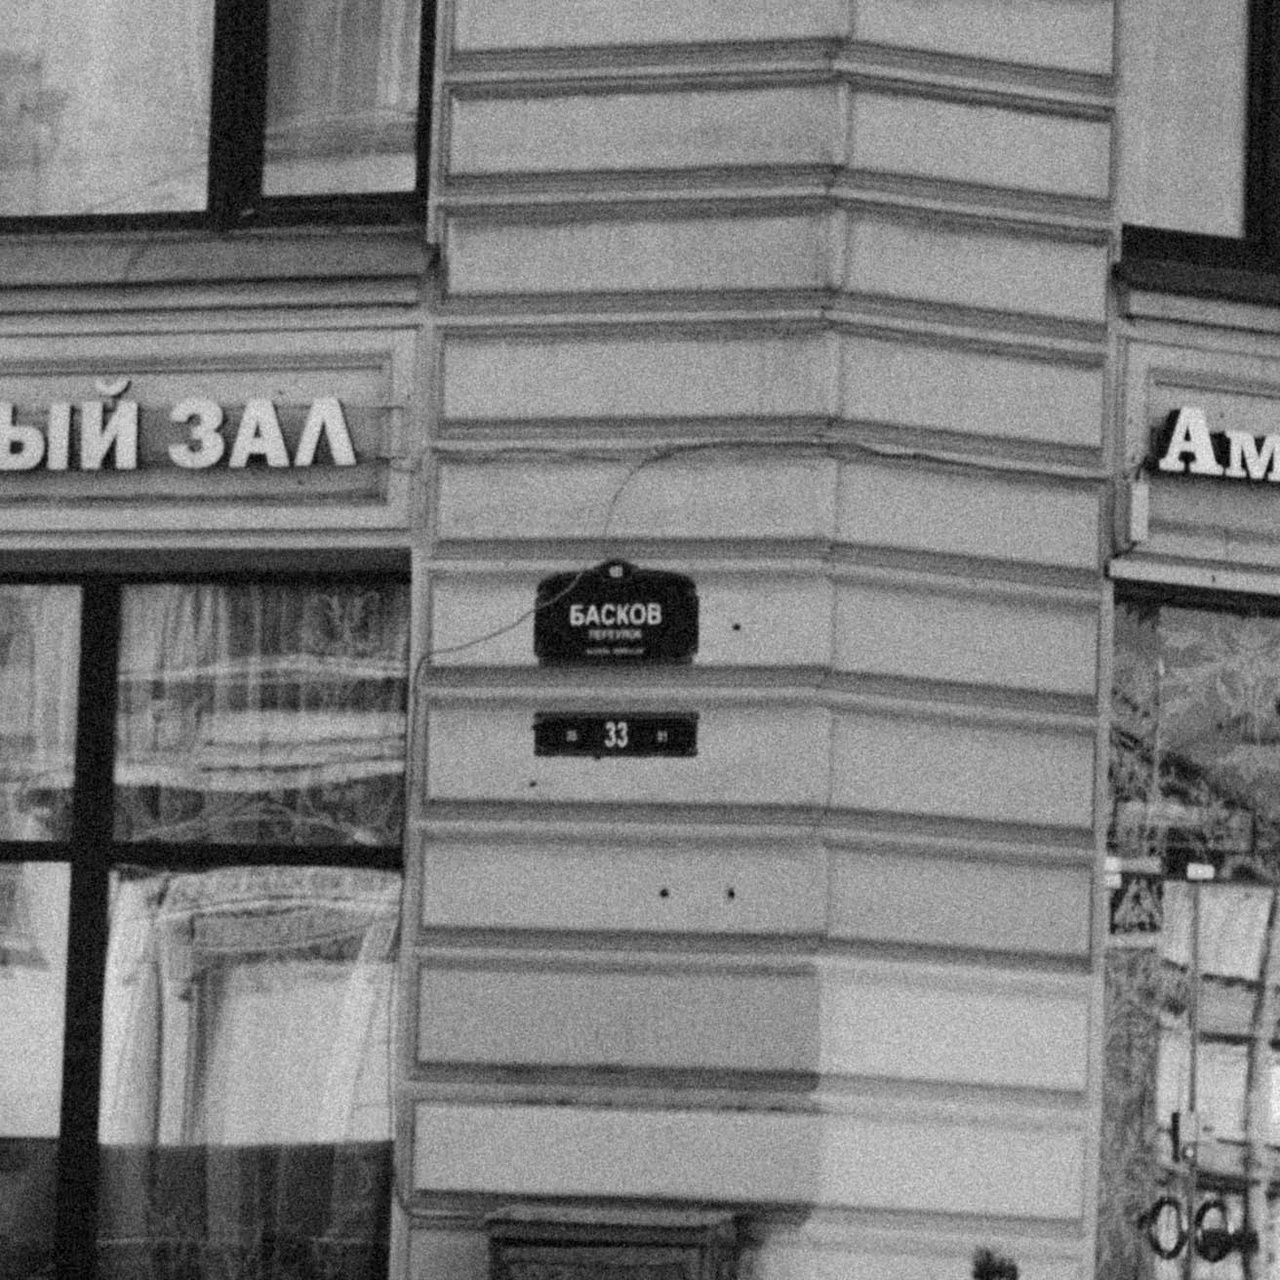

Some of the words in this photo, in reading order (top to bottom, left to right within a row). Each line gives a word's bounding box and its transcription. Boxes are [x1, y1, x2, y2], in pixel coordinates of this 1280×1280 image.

[168, 396, 358, 469] ЗАЛ
[569, 602, 663, 626] БАСКОВ
[604, 721, 629, 748] 33
